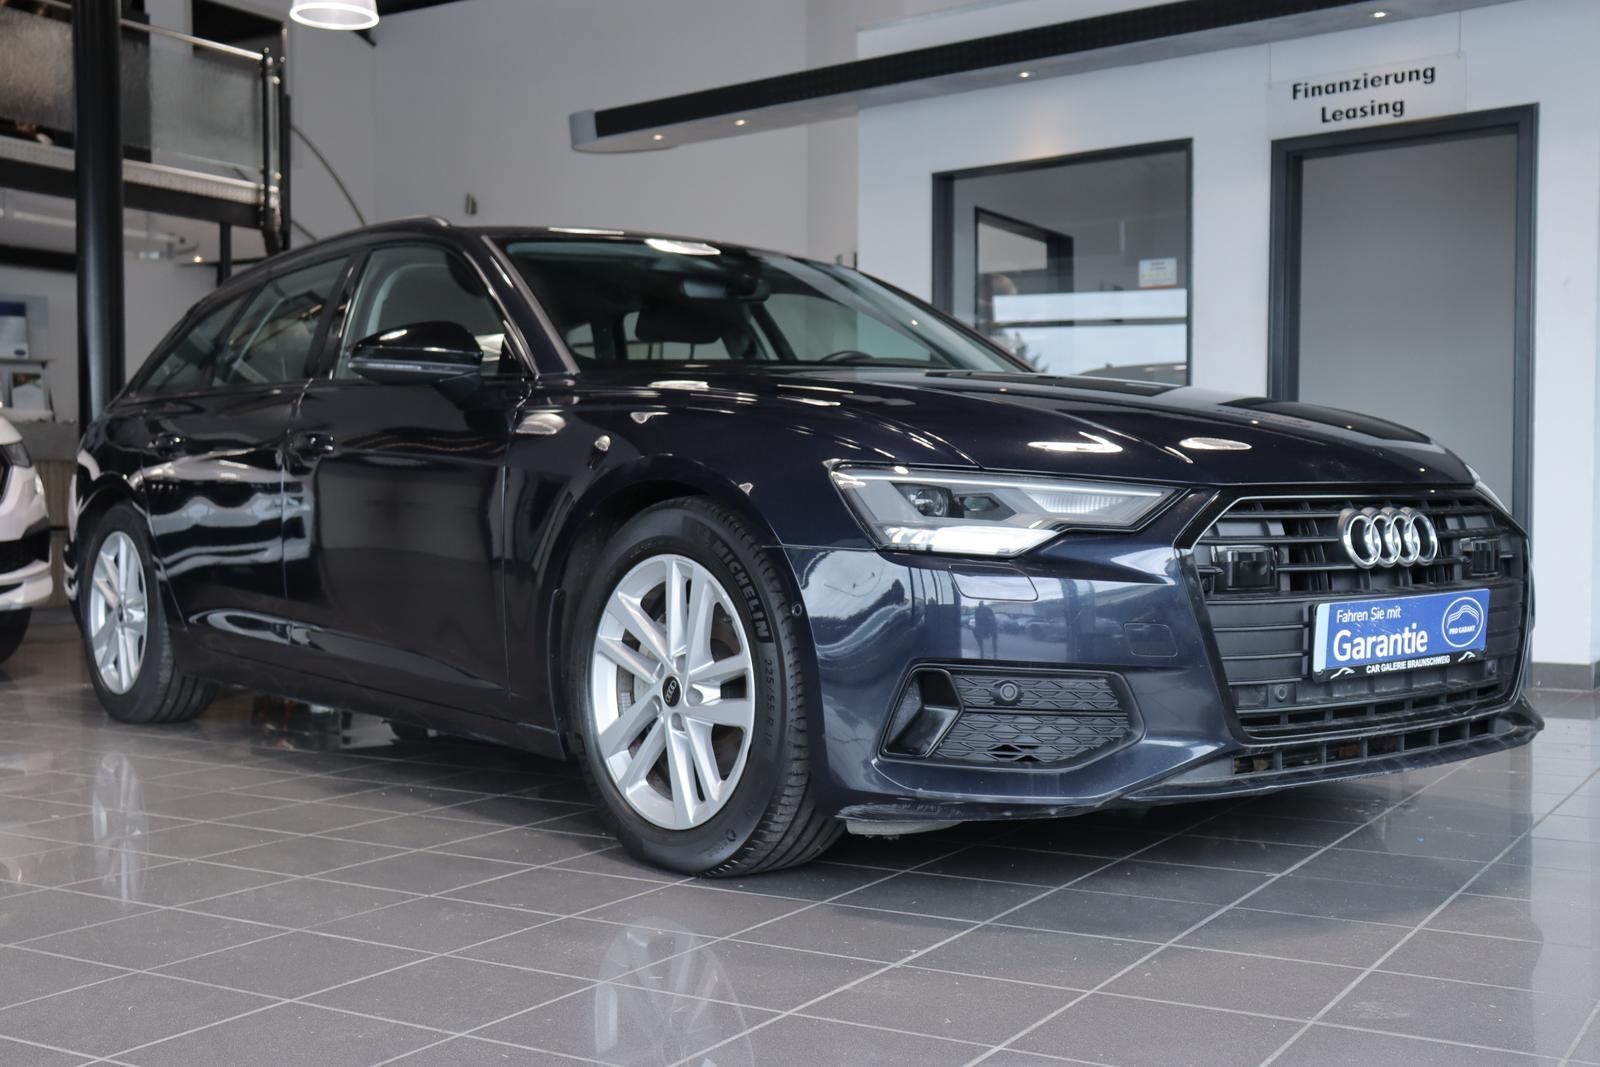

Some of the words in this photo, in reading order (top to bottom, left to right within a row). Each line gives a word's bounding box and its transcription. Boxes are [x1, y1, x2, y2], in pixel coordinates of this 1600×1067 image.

[1292, 66, 1436, 100] Finanzierung
[1321, 100, 1405, 123] Leasing
[711, 540, 771, 638] MICHELIN
[1336, 608, 1369, 624] Fahren
[1370, 607, 1385, 620] Sie
[1386, 605, 1402, 619] mit
[1333, 623, 1429, 662] Garantie
[1366, 663, 1381, 674] CAR
[1381, 659, 1407, 672] GALERIE
[1407, 655, 1451, 669] BRAUNSCHWEIG
